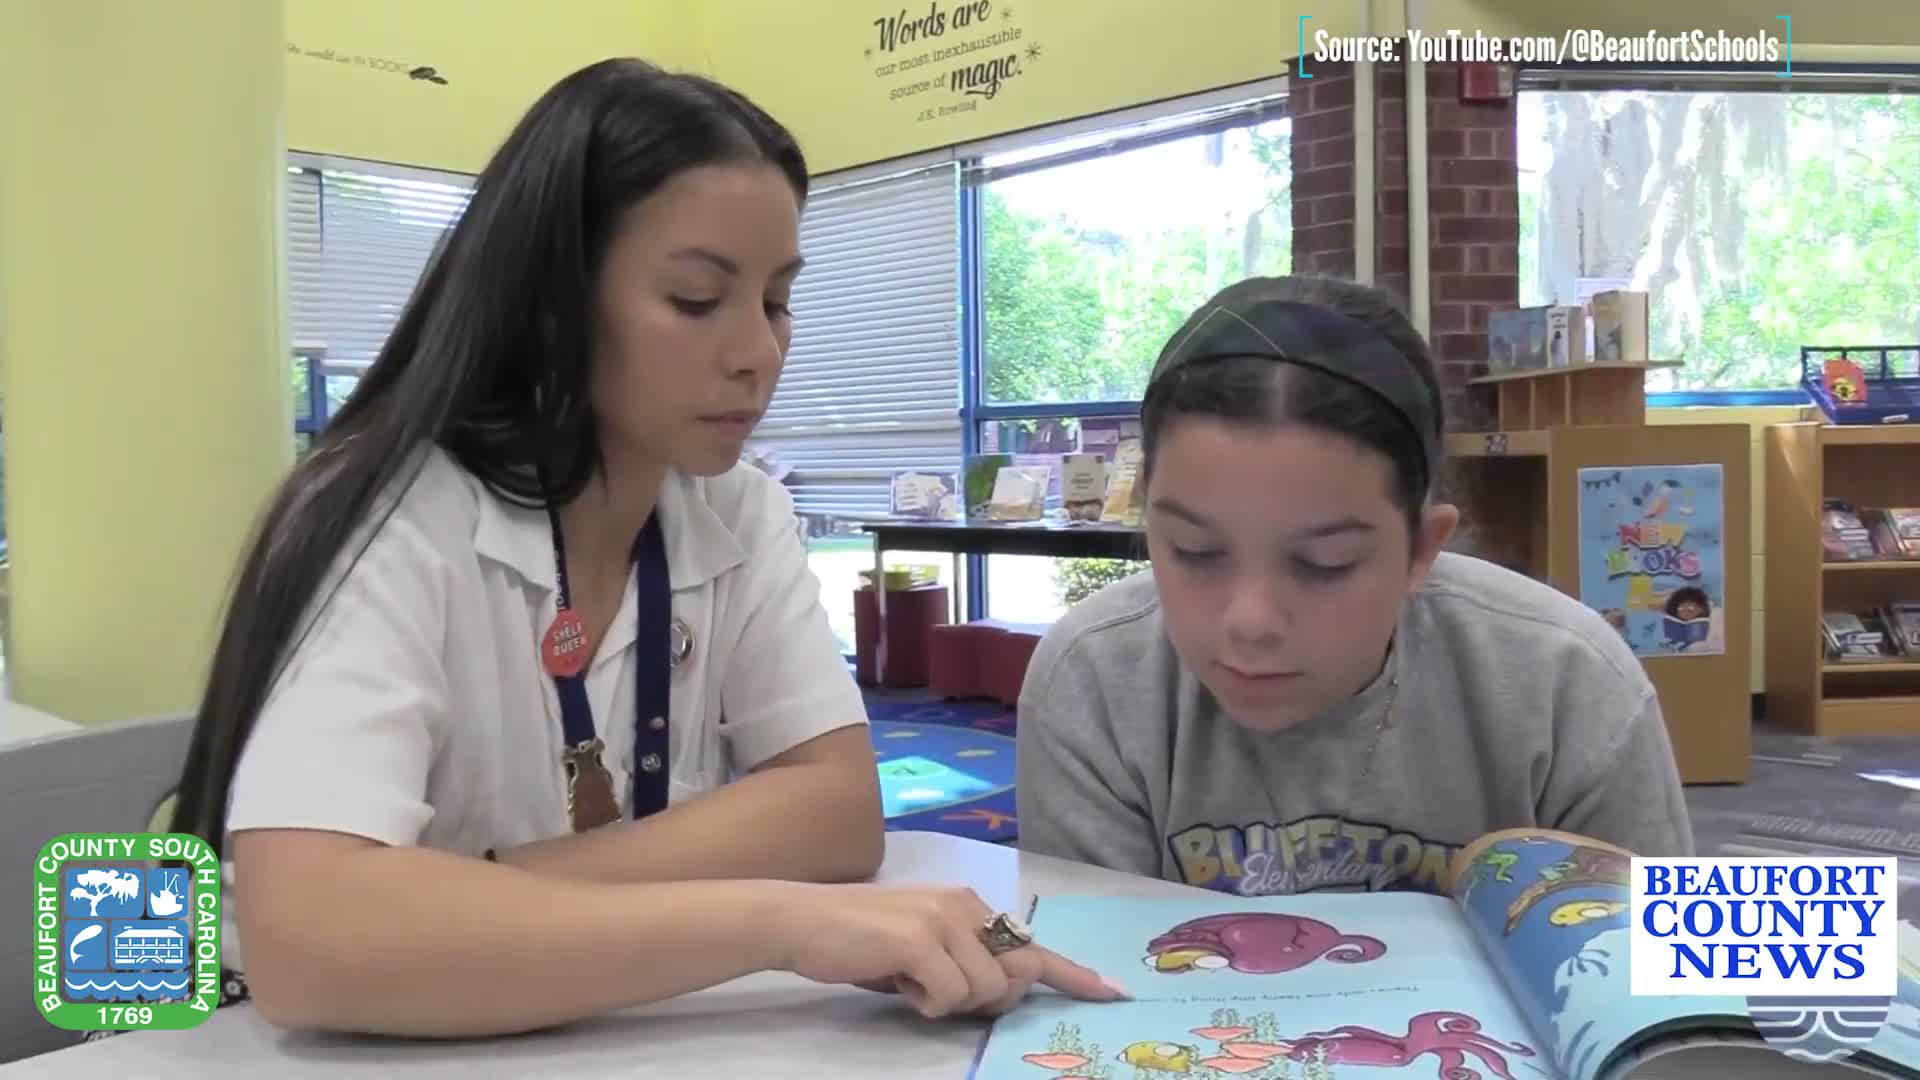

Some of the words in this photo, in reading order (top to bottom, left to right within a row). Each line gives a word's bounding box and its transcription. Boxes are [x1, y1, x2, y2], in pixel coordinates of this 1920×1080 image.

[873, 2, 945, 51] Words
[952, 0, 991, 29] are
[875, 63, 897, 78] our
[899, 53, 930, 73] most
[933, 27, 1022, 63] inexhaustible
[889, 79, 930, 100] source
[933, 73, 946, 89] of
[951, 54, 1022, 100] magic.
